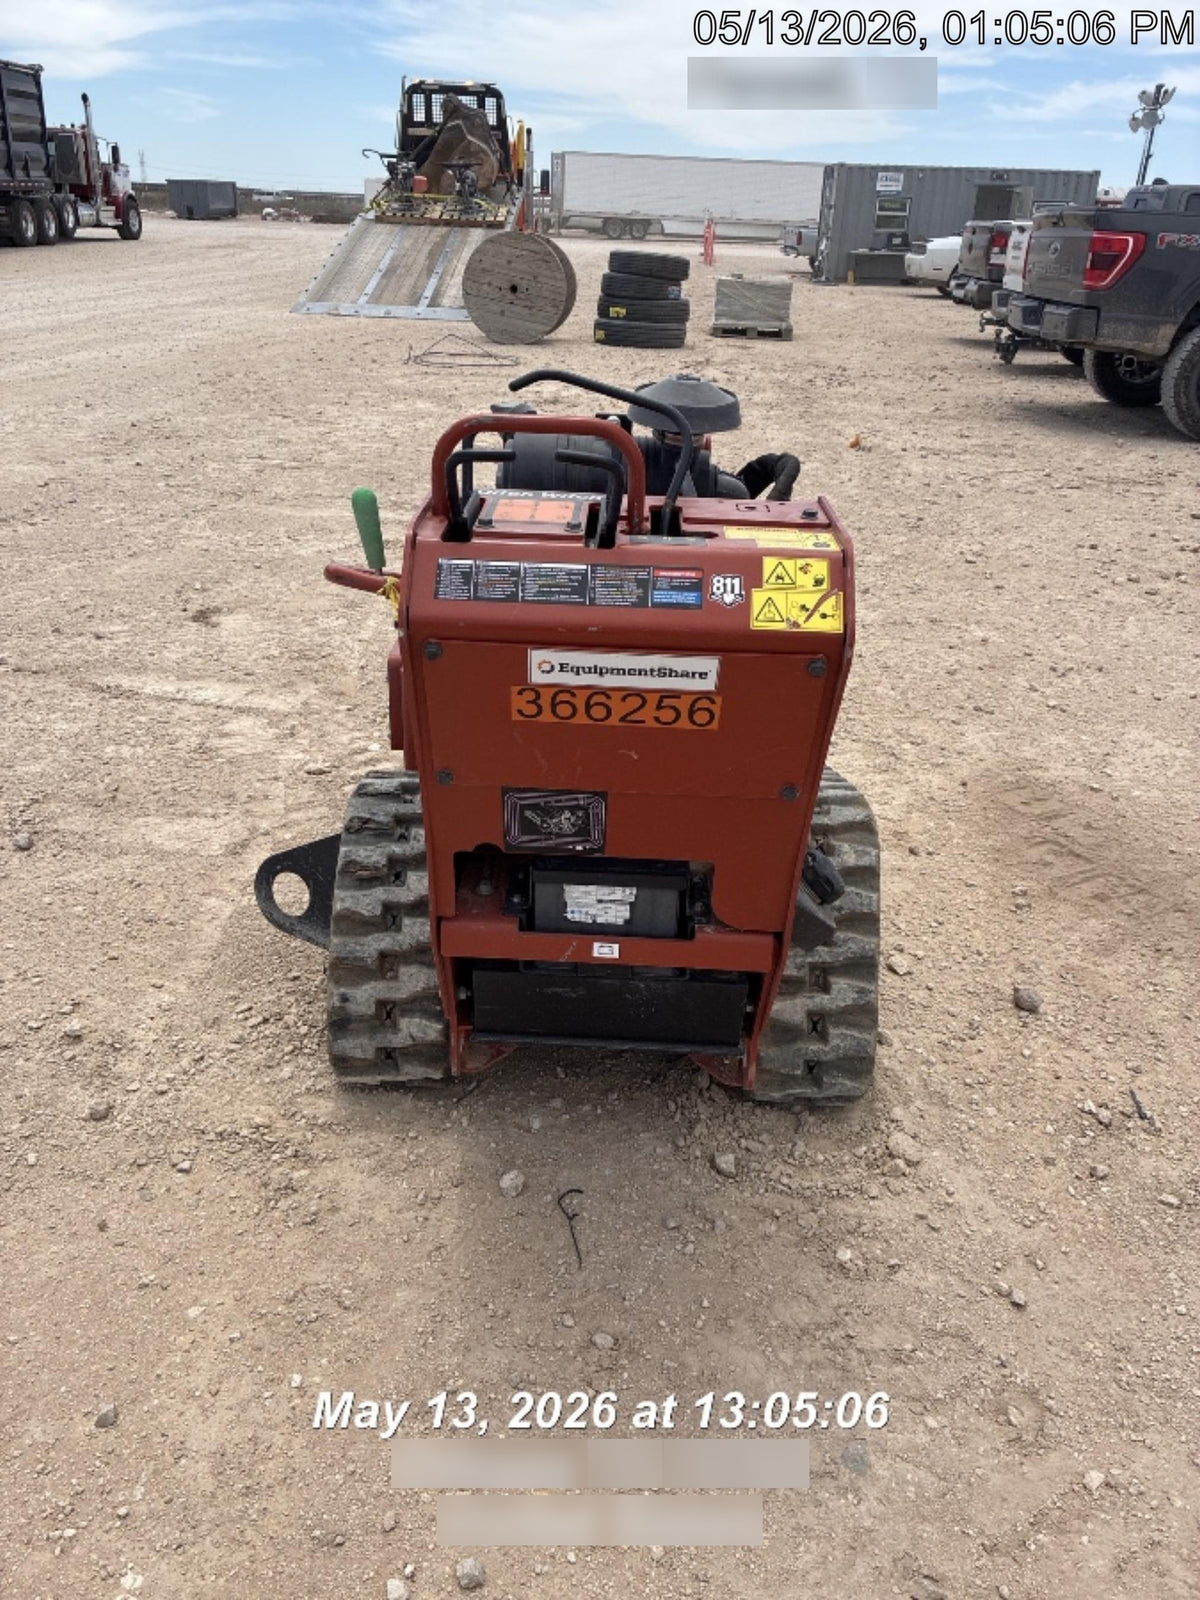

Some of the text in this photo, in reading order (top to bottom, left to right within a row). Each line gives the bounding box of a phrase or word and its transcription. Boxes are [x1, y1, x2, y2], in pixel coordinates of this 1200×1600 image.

[711, 576, 741, 596] 811
[557, 662, 709, 680] EquipmentShare
[516, 687, 716, 728] 366256
